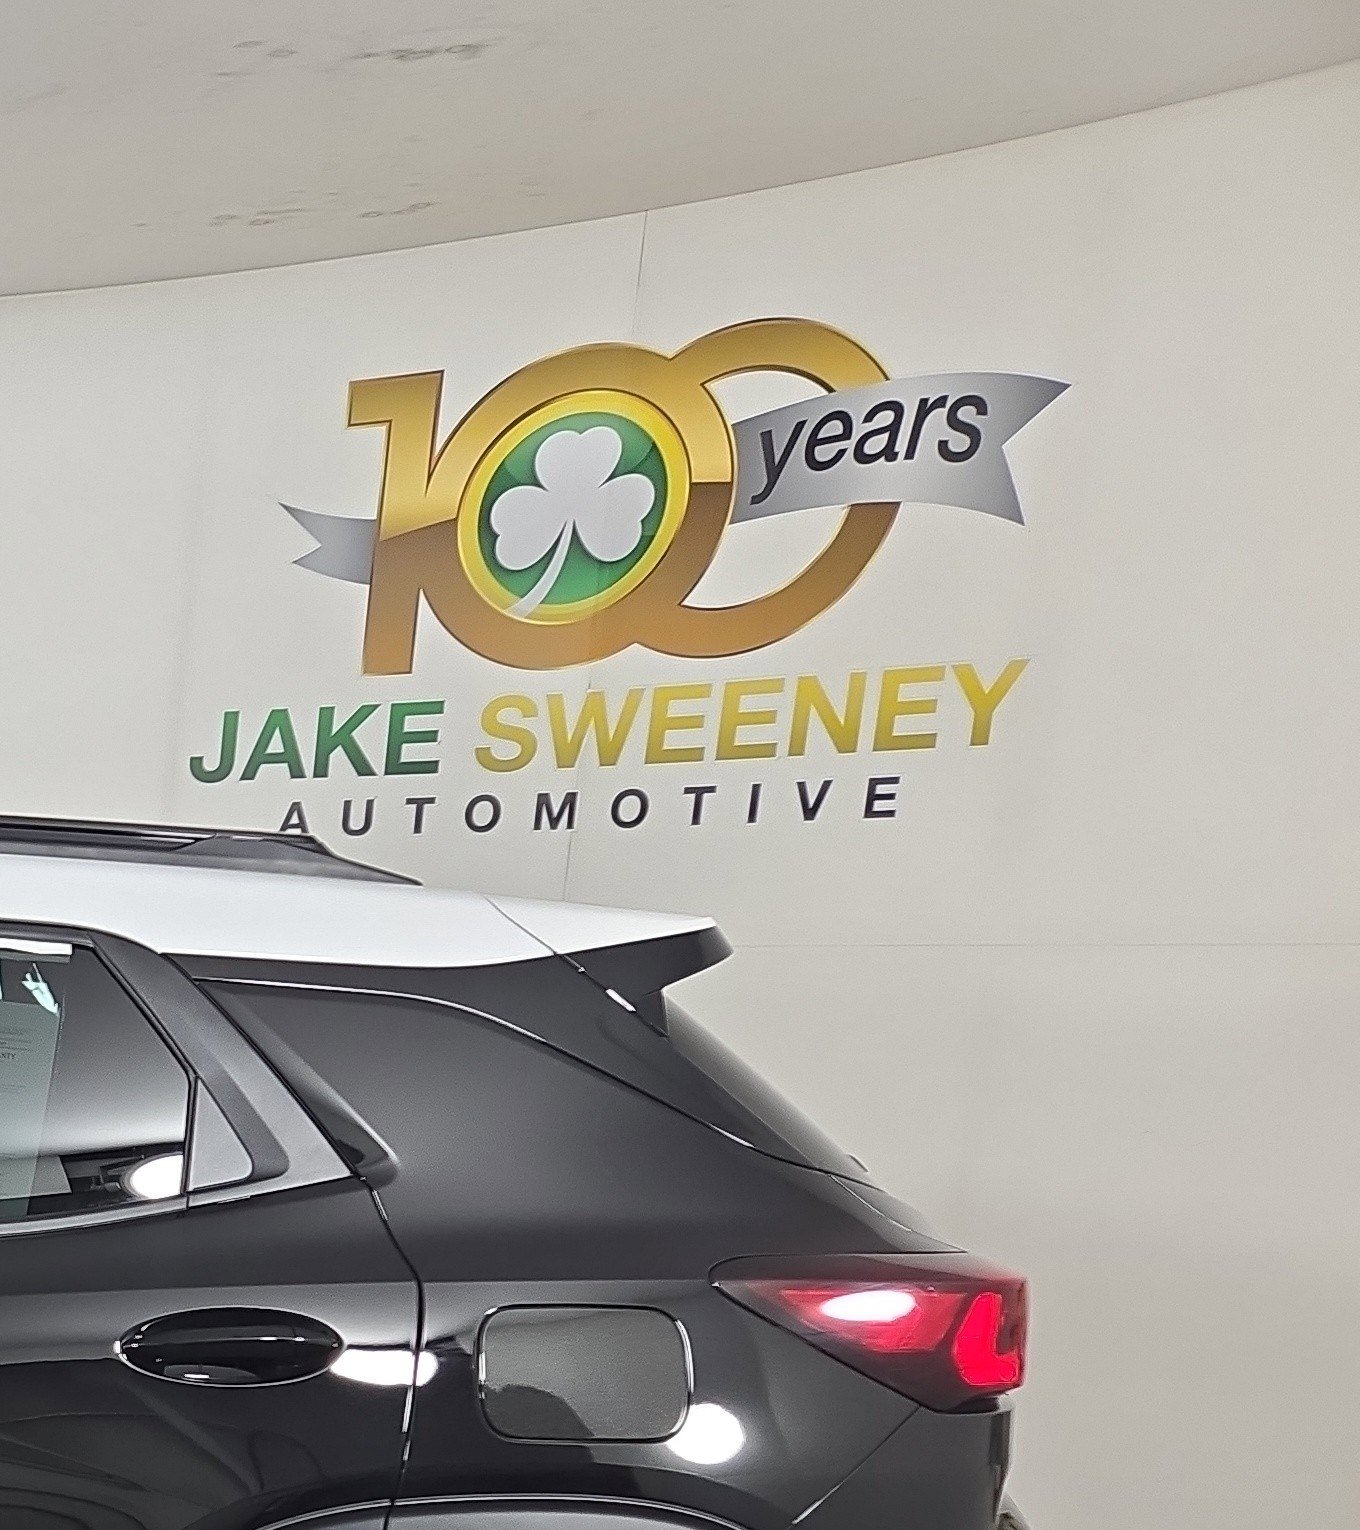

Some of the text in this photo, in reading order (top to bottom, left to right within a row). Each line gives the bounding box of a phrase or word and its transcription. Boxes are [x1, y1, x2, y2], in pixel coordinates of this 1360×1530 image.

[749, 392, 989, 506] years
[188, 657, 1031, 783] JAKE SWEENEY
[279, 775, 903, 836] AUTOMOTIVE
